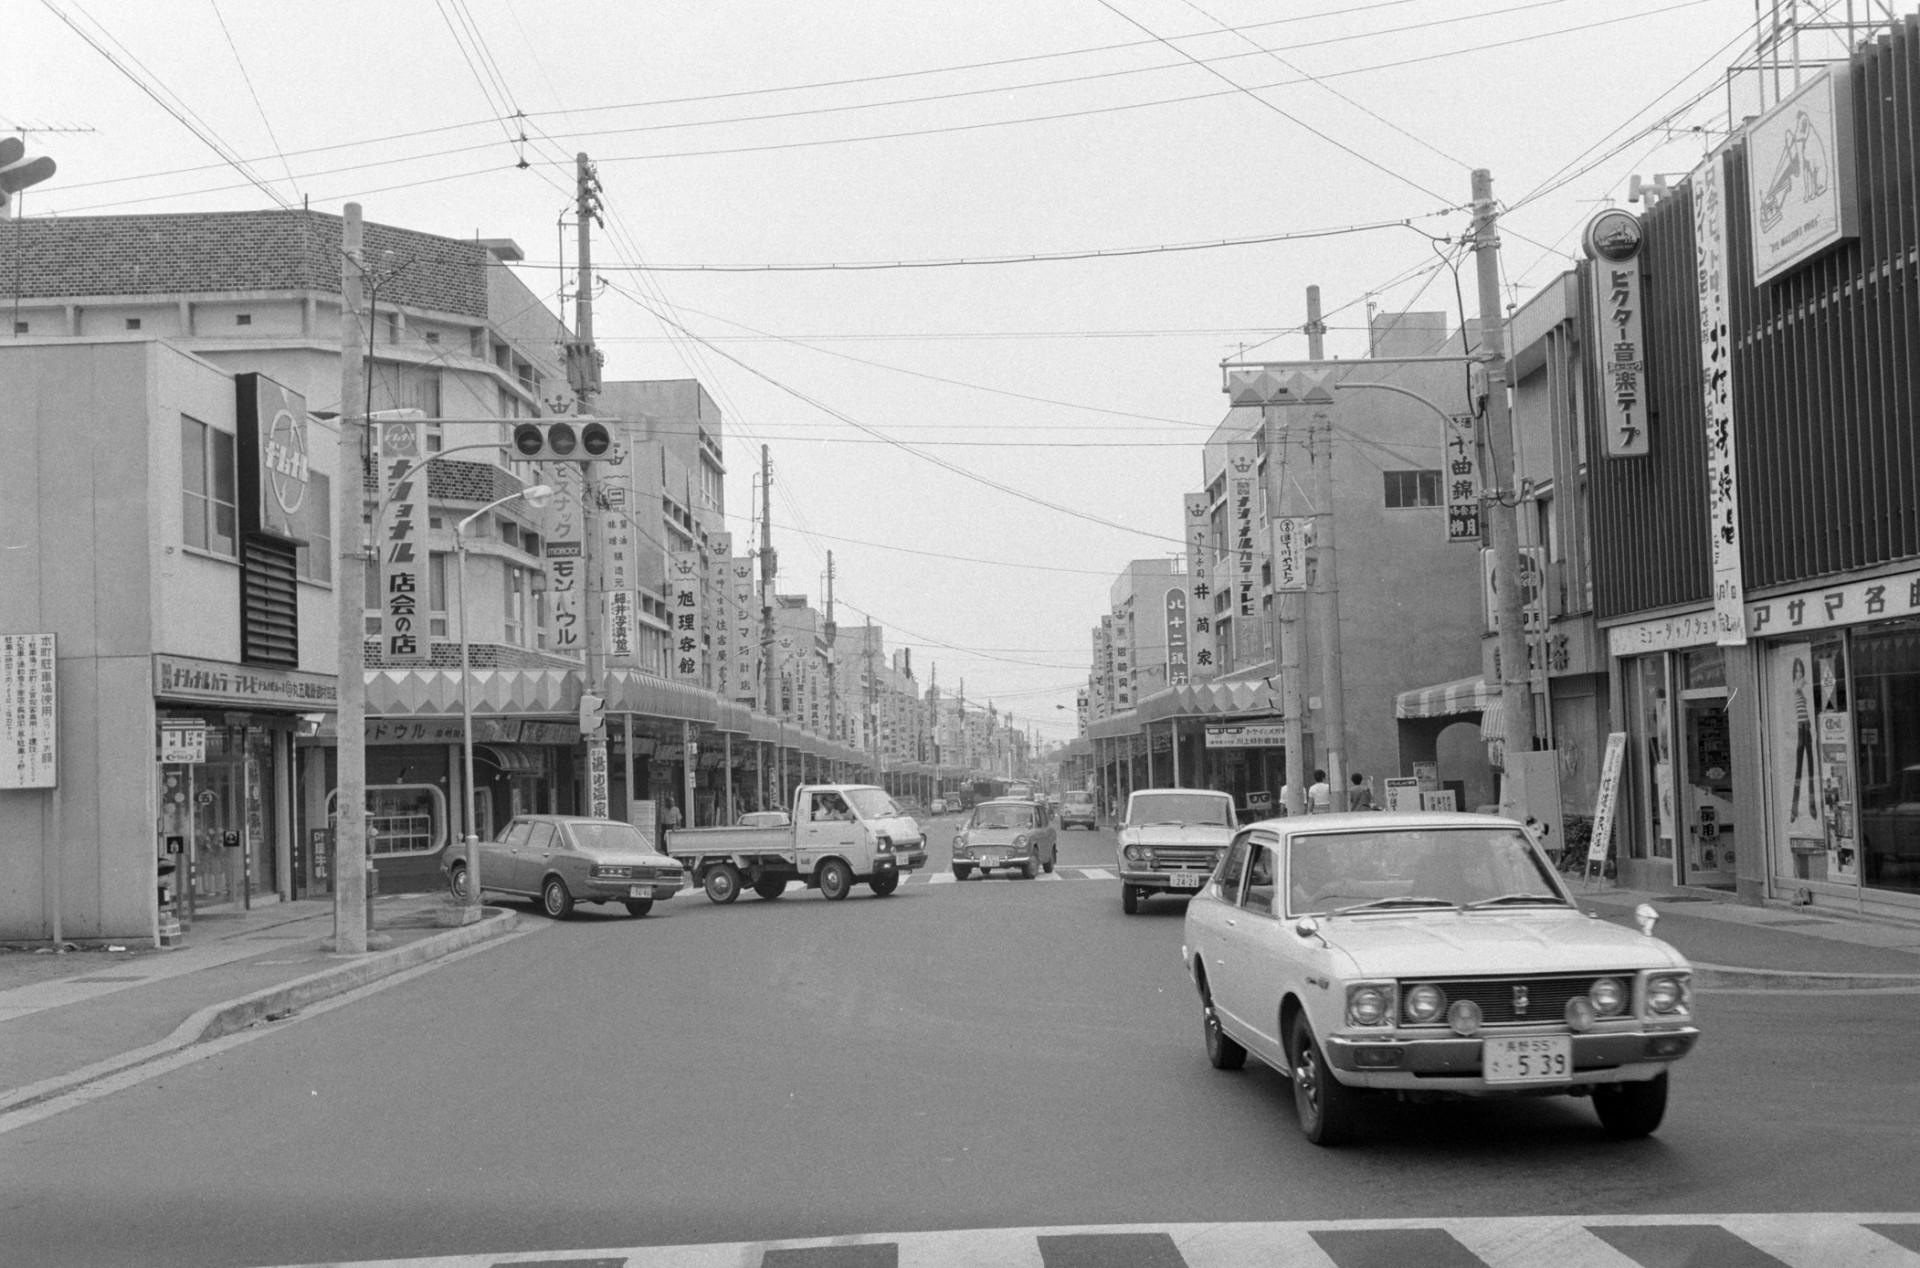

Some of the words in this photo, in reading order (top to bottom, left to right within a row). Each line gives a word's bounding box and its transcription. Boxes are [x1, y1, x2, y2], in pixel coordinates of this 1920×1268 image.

[1611, 268, 1640, 447] ビクター音楽テープ
[265, 440, 309, 483] ナショナル
[553, 461, 573, 539] とスナック
[1168, 599, 1187, 685] 八十二銀行
[1194, 582, 1213, 666] 井筒家
